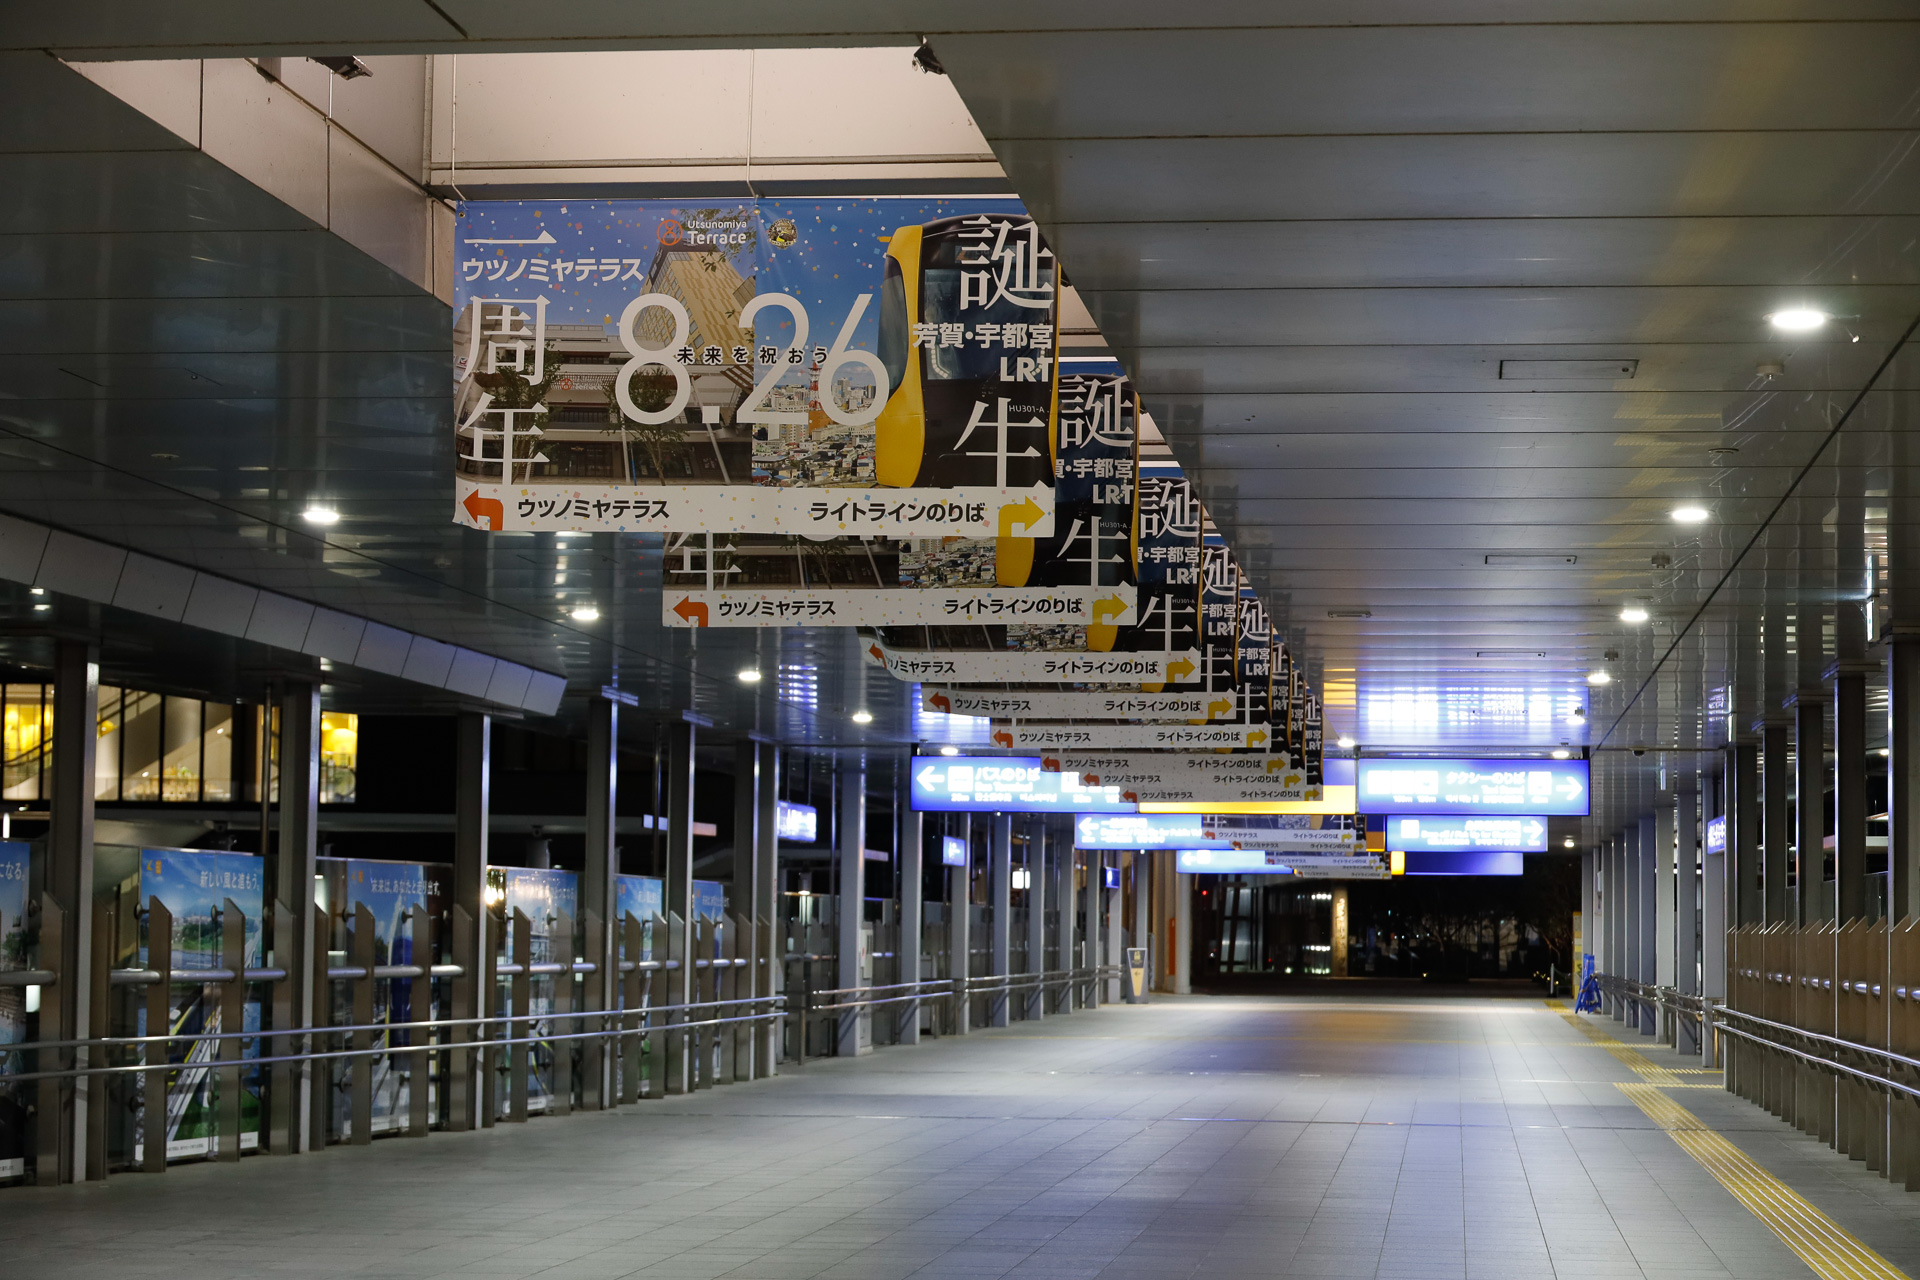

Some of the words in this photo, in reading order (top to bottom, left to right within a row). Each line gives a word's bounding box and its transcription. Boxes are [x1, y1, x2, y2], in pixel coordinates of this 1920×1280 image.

[687, 220, 747, 230] Utsunomiya
[687, 231, 747, 245] Terrace
[462, 258, 644, 282] ウツノミヤテラス
[912, 322, 1054, 349] 芳賀・宇都宮
[615, 292, 890, 426] 8.26
[677, 346, 828, 365] 未来を祝おう
[1000, 357, 1054, 382] LRT
[1009, 405, 1045, 414] HU301-A
[1092, 484, 1134, 504] LRT
[518, 499, 670, 519] ウツノミヤテラス
[810, 502, 986, 523] ライトラインのりば
[1166, 567, 1200, 584] LRT
[719, 601, 836, 616] ウツノミヤテラス
[944, 598, 1083, 614] ライトラインのりば
[1208, 621, 1237, 636] LRT
[1044, 661, 1158, 674] ライトラインのりば
[1246, 663, 1270, 676] LRT
[955, 699, 1031, 711] ウツノミヤテラス
[1105, 701, 1201, 712] ライトラインのりば
[1019, 732, 1091, 742] ウツノミヤテラス
[1157, 732, 1240, 742] ライトラインのりば
[1065, 759, 1129, 768] ウツノミヤテラス
[1187, 760, 1262, 768] ライトラインのりば
[1104, 775, 1161, 783] ウツノミヤテラス
[1213, 775, 1280, 783] ライトラインのりば
